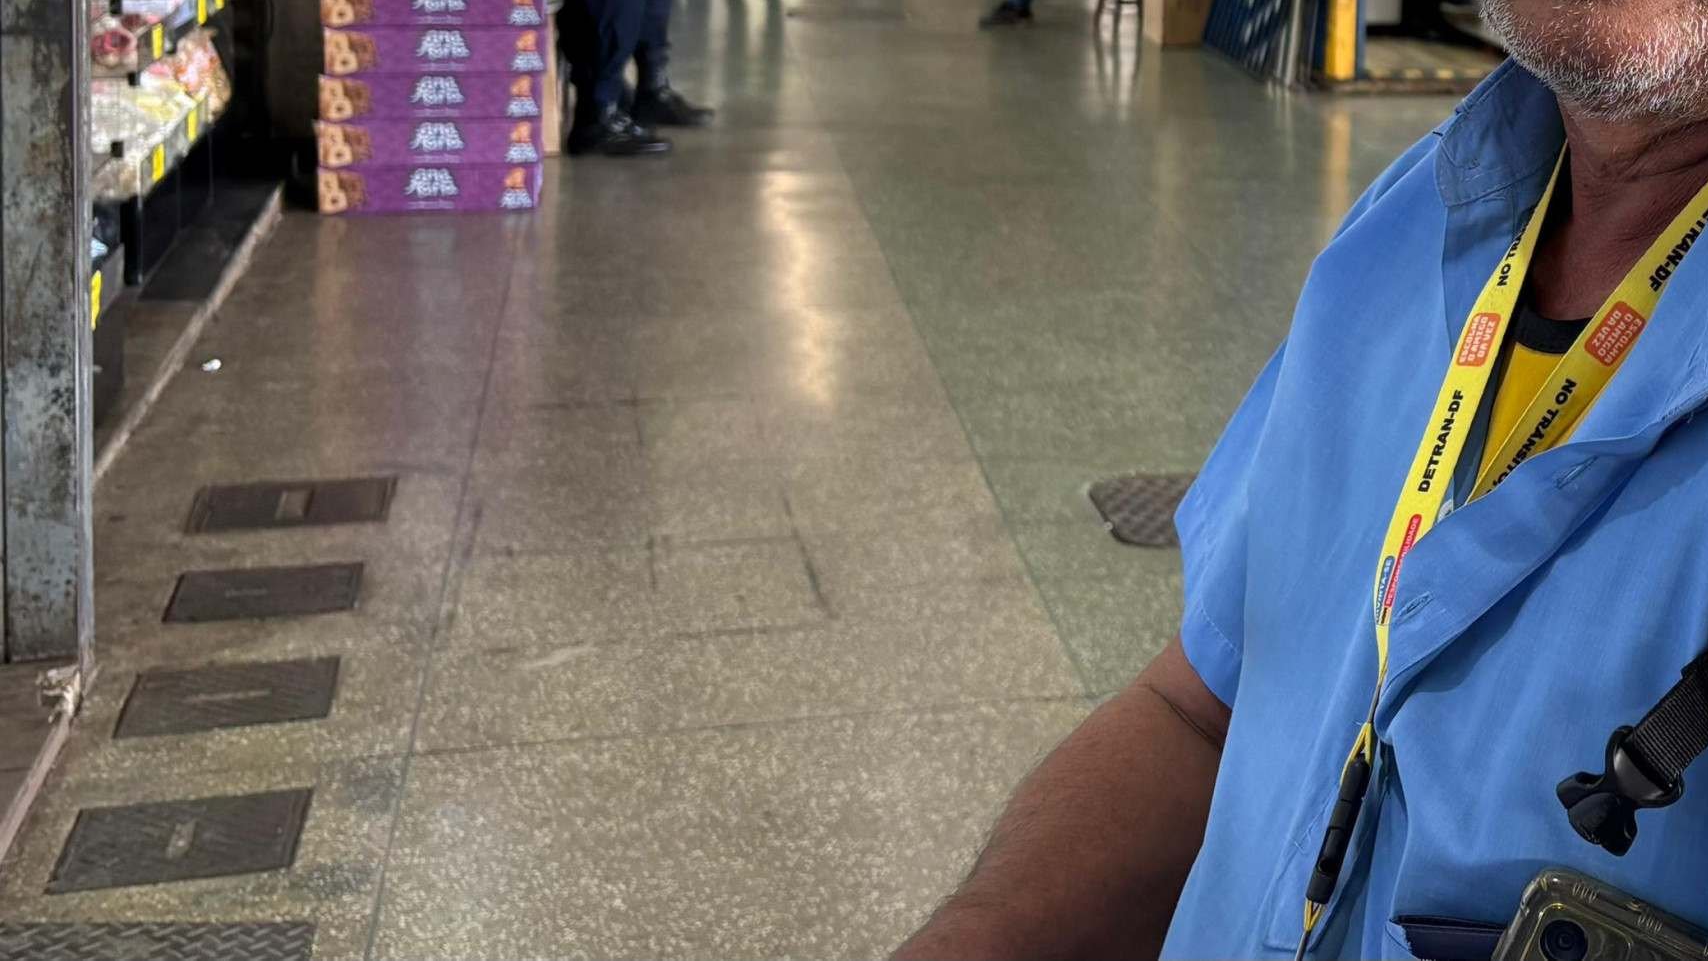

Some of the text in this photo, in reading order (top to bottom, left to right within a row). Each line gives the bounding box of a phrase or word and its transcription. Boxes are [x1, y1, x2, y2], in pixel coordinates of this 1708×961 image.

[1496, 263, 1512, 287] NO
[1597, 321, 1626, 357] AMIGO
[1604, 318, 1643, 364] ESCOLHA
[1555, 378, 1578, 406] NO
[1417, 389, 1464, 493] DETRAN-DF
